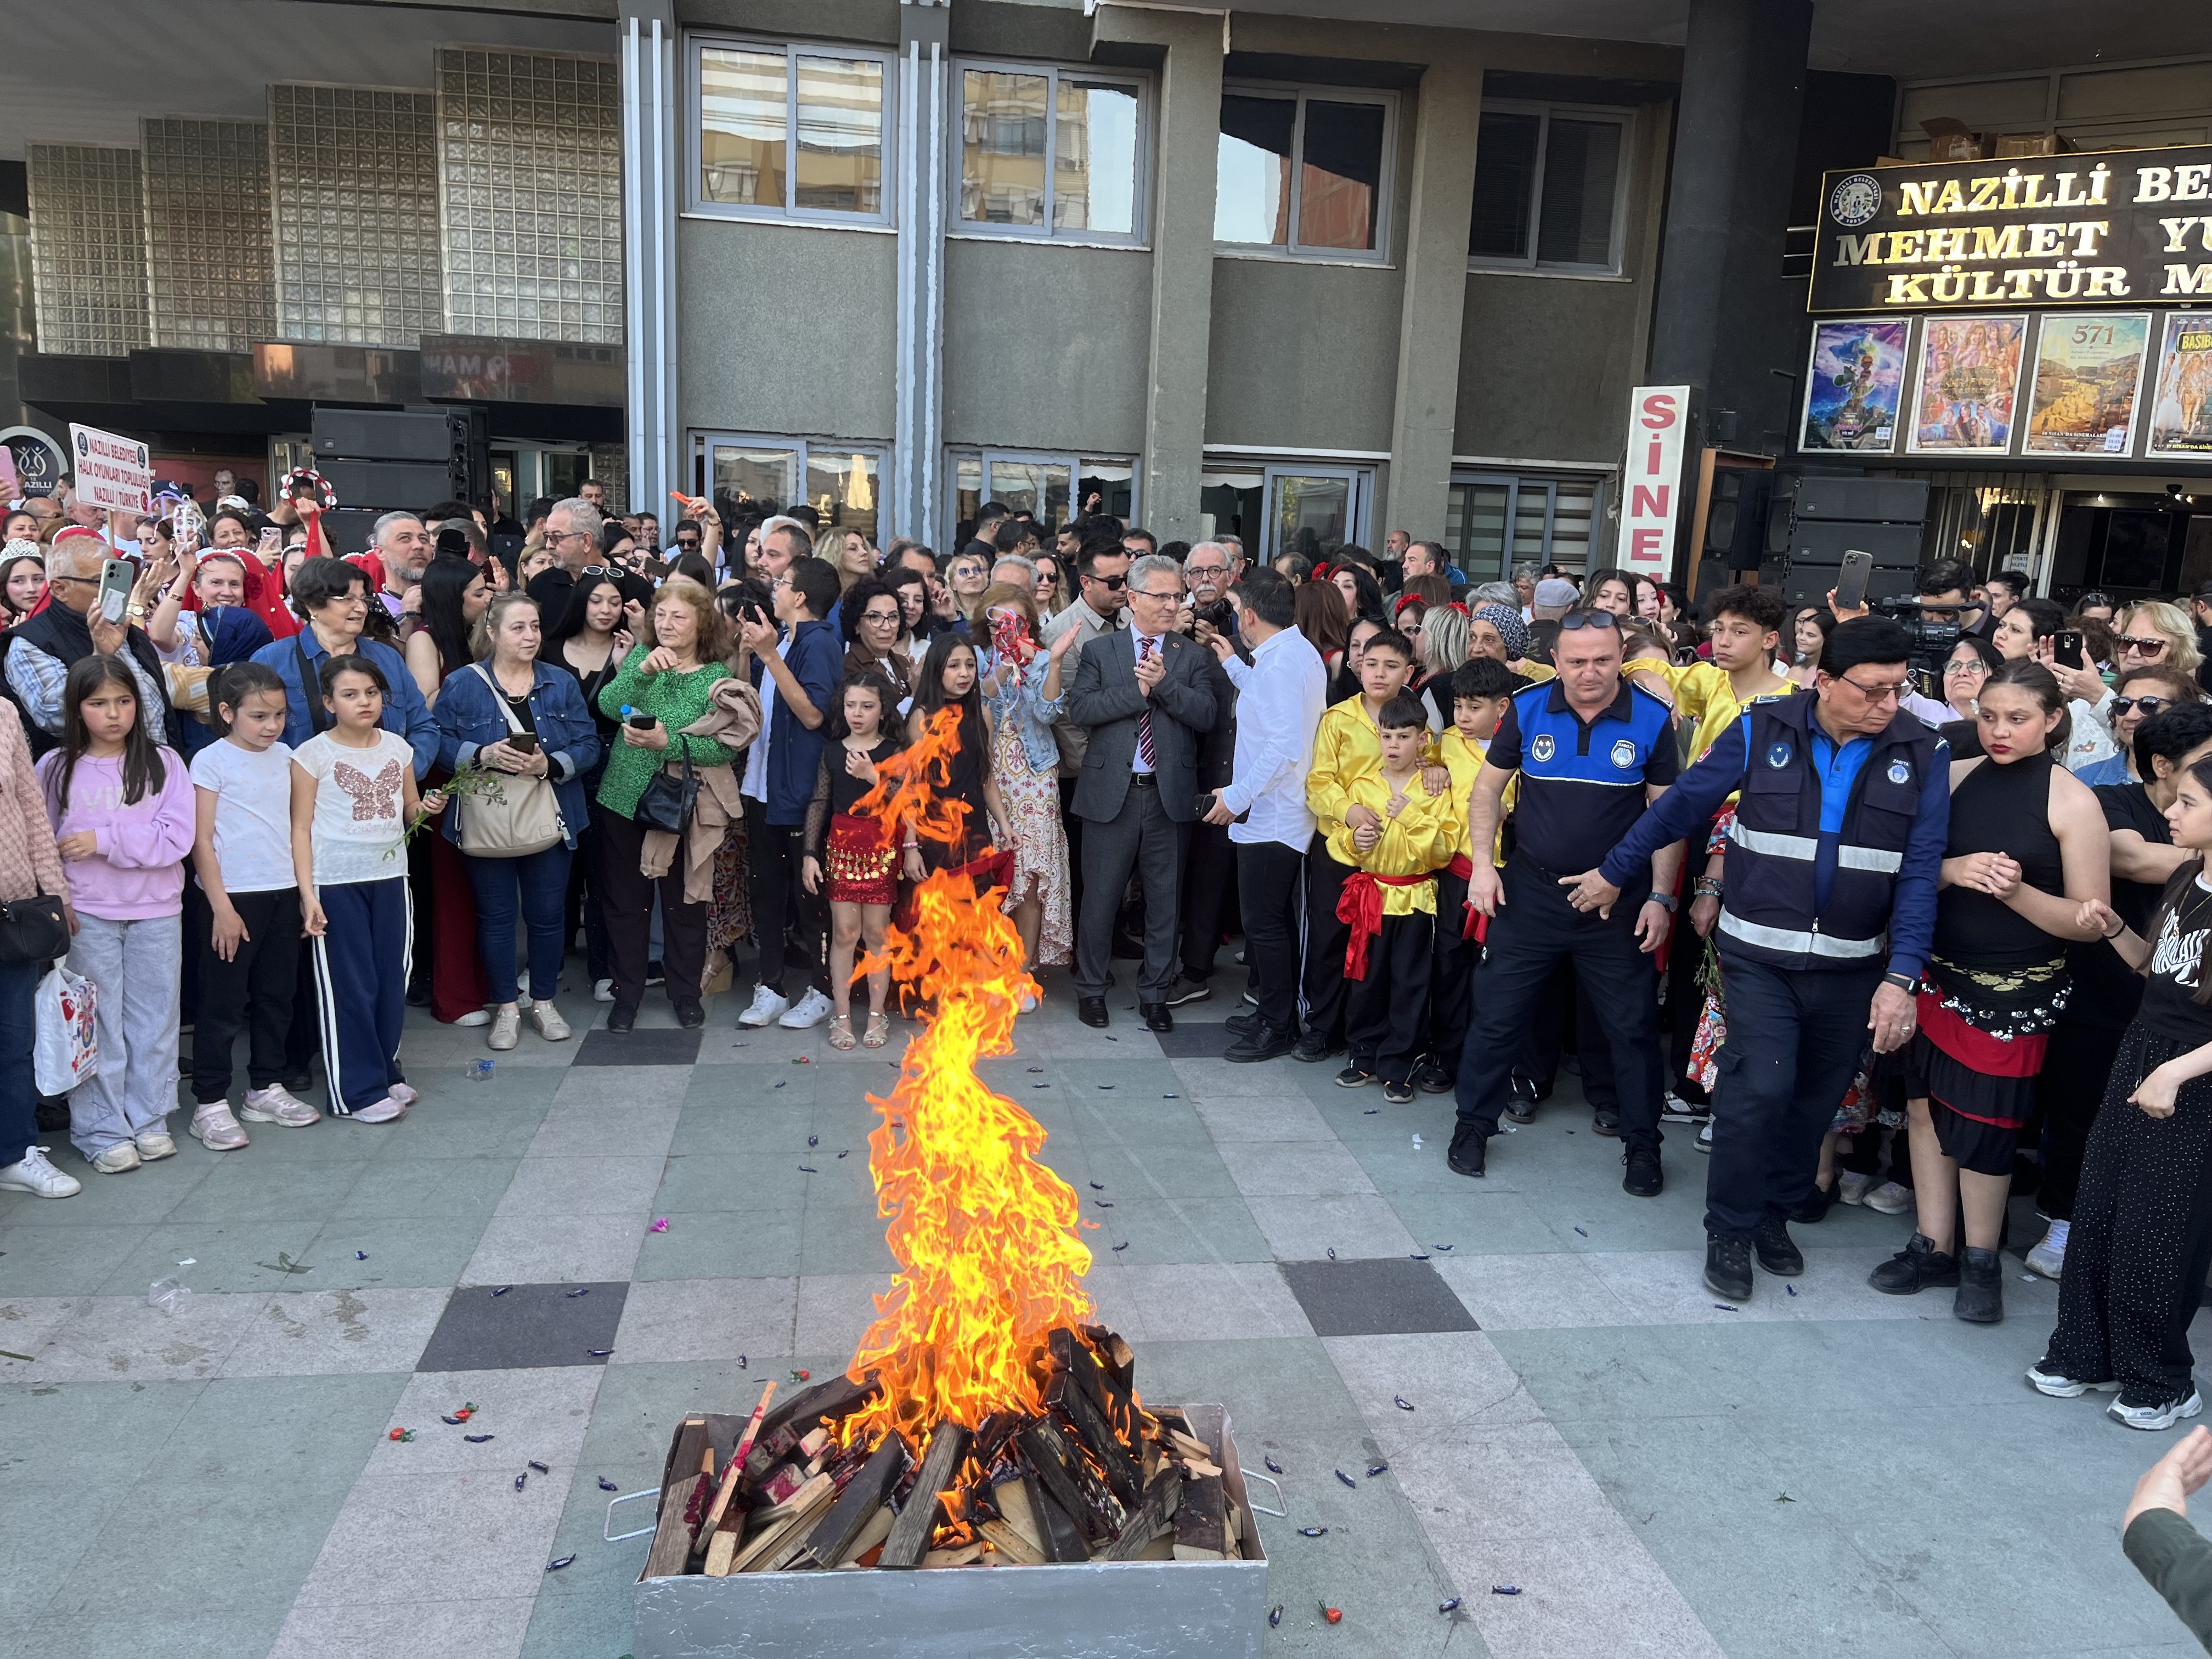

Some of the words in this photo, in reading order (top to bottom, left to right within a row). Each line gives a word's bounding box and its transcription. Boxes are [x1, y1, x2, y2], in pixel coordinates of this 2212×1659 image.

[1897, 162, 2111, 216] NAZİLLİ
[2133, 163, 2212, 202] BE
[1833, 221, 2109, 266] MEHMET
[1884, 260, 2130, 303] KÜLTÜR
[2072, 325, 2114, 345] 571
[2182, 335, 2212, 349] BAŞIB
[78, 458, 93, 476] HALK
[94, 462, 120, 482] OYUNLARI
[1627, 394, 1676, 583] SİNE
